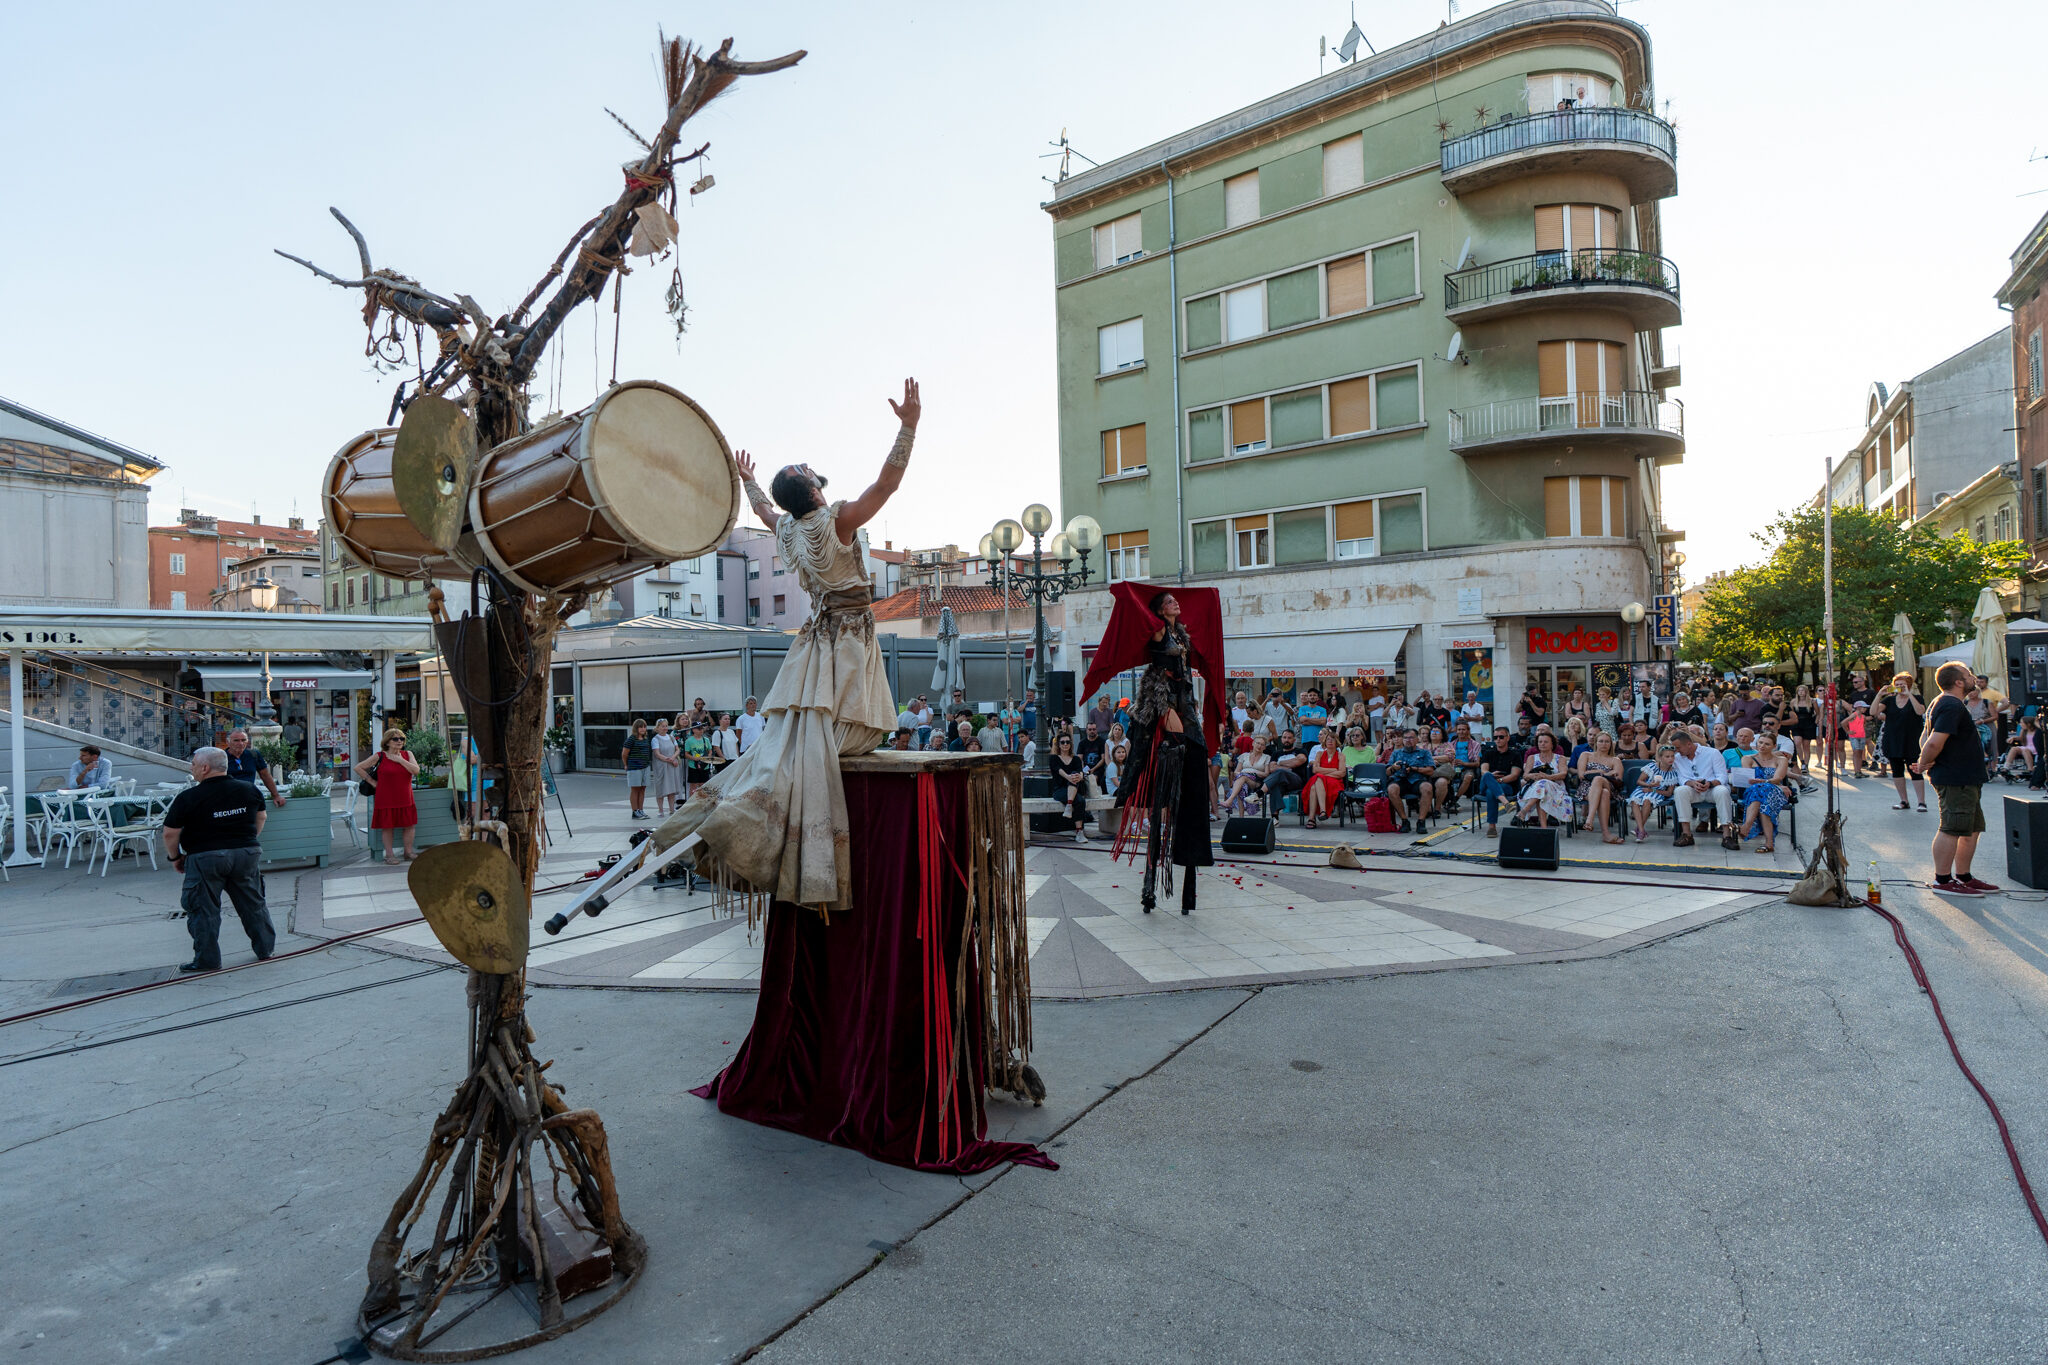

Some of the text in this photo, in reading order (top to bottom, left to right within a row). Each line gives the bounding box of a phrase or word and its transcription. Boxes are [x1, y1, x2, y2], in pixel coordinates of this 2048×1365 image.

[1658, 597, 1673, 637] URAR
[0, 632, 83, 643] S 1903.
[1528, 624, 1619, 654] Rodea
[1453, 639, 1483, 648] Rodea
[1270, 669, 1295, 677] Rodea
[1312, 668, 1338, 677] Rodea
[1357, 667, 1385, 676] Rodea
[284, 680, 317, 688] TISAK
[213, 807, 247, 818] SECURITY
